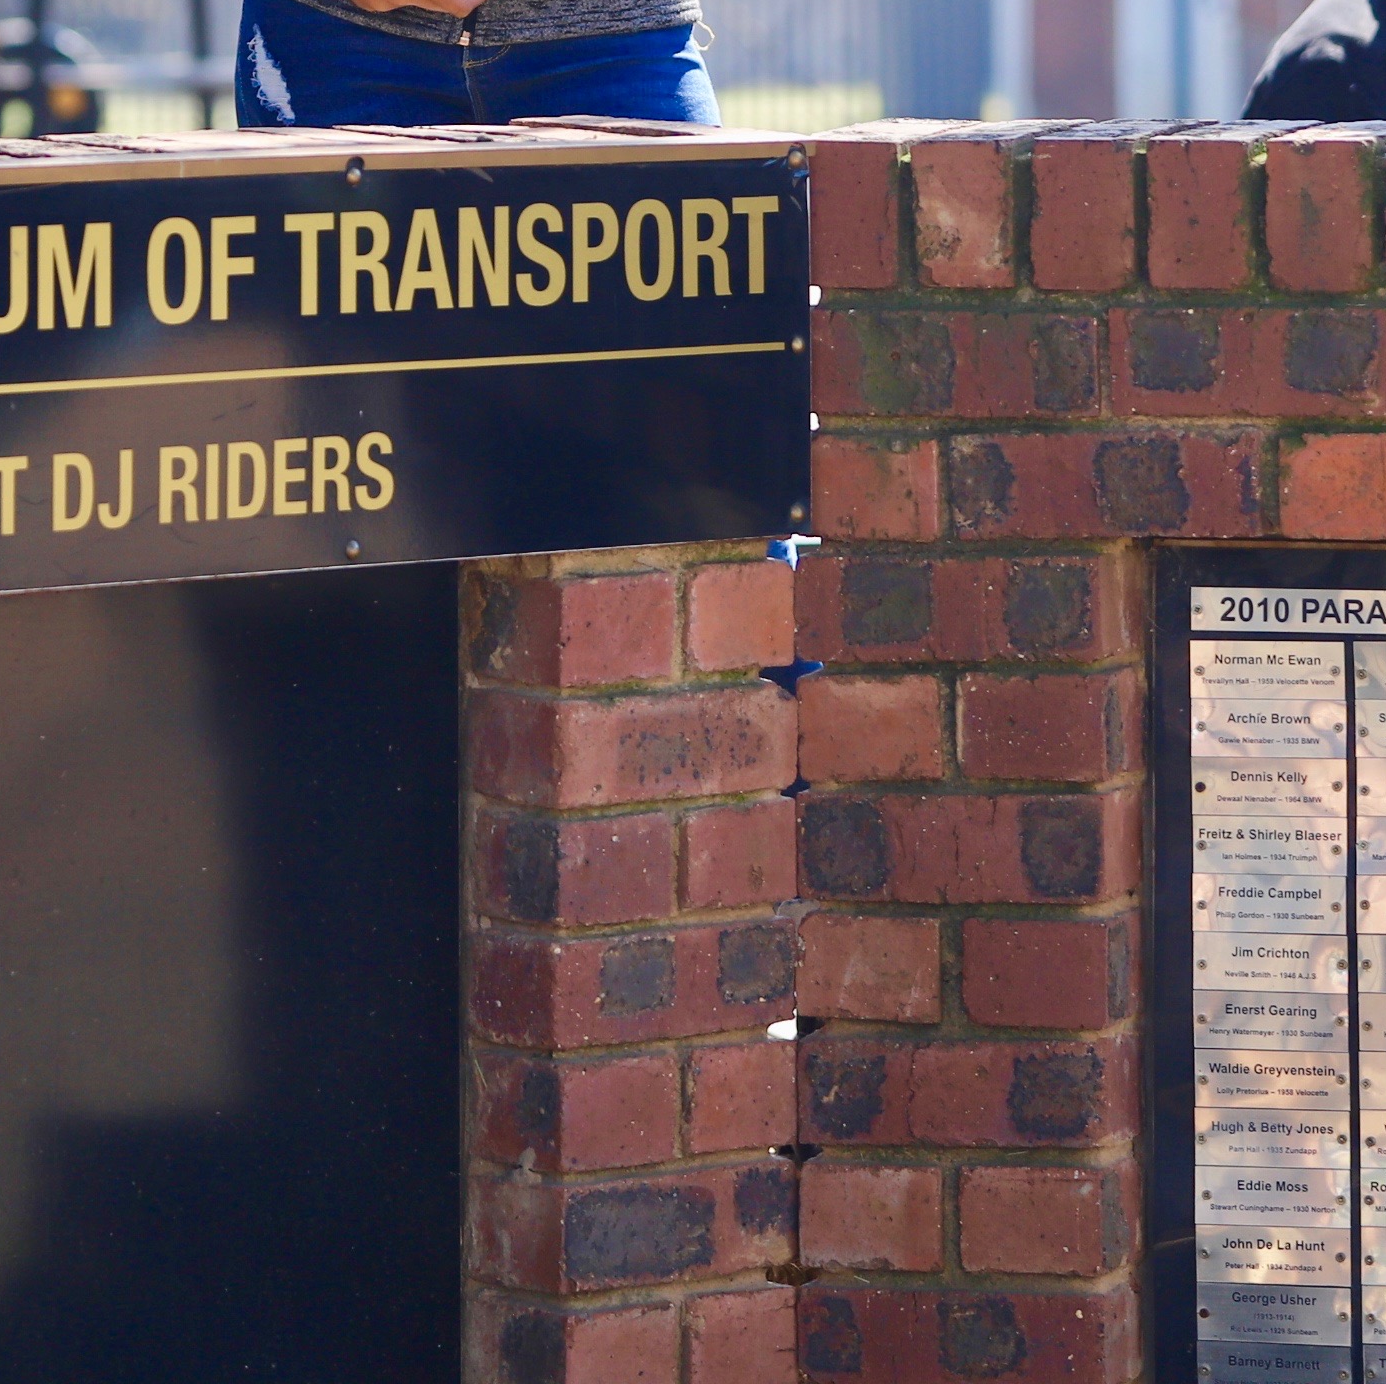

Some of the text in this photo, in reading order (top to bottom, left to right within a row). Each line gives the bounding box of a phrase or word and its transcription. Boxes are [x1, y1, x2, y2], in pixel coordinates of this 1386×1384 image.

[148, 216, 255, 324] OF
[285, 197, 778, 315] TRANSPORT
[52, 449, 134, 532] DJ
[159, 432, 394, 524] RIDERS
[1220, 597, 1290, 623] 2010
[1214, 652, 1321, 665] Norman Mc Ewan
[1226, 712, 1311, 724] Archie Brown
[1217, 885, 1321, 901] Freddie Campbel
[1236, 1178, 1308, 1192] Eddie Moss
